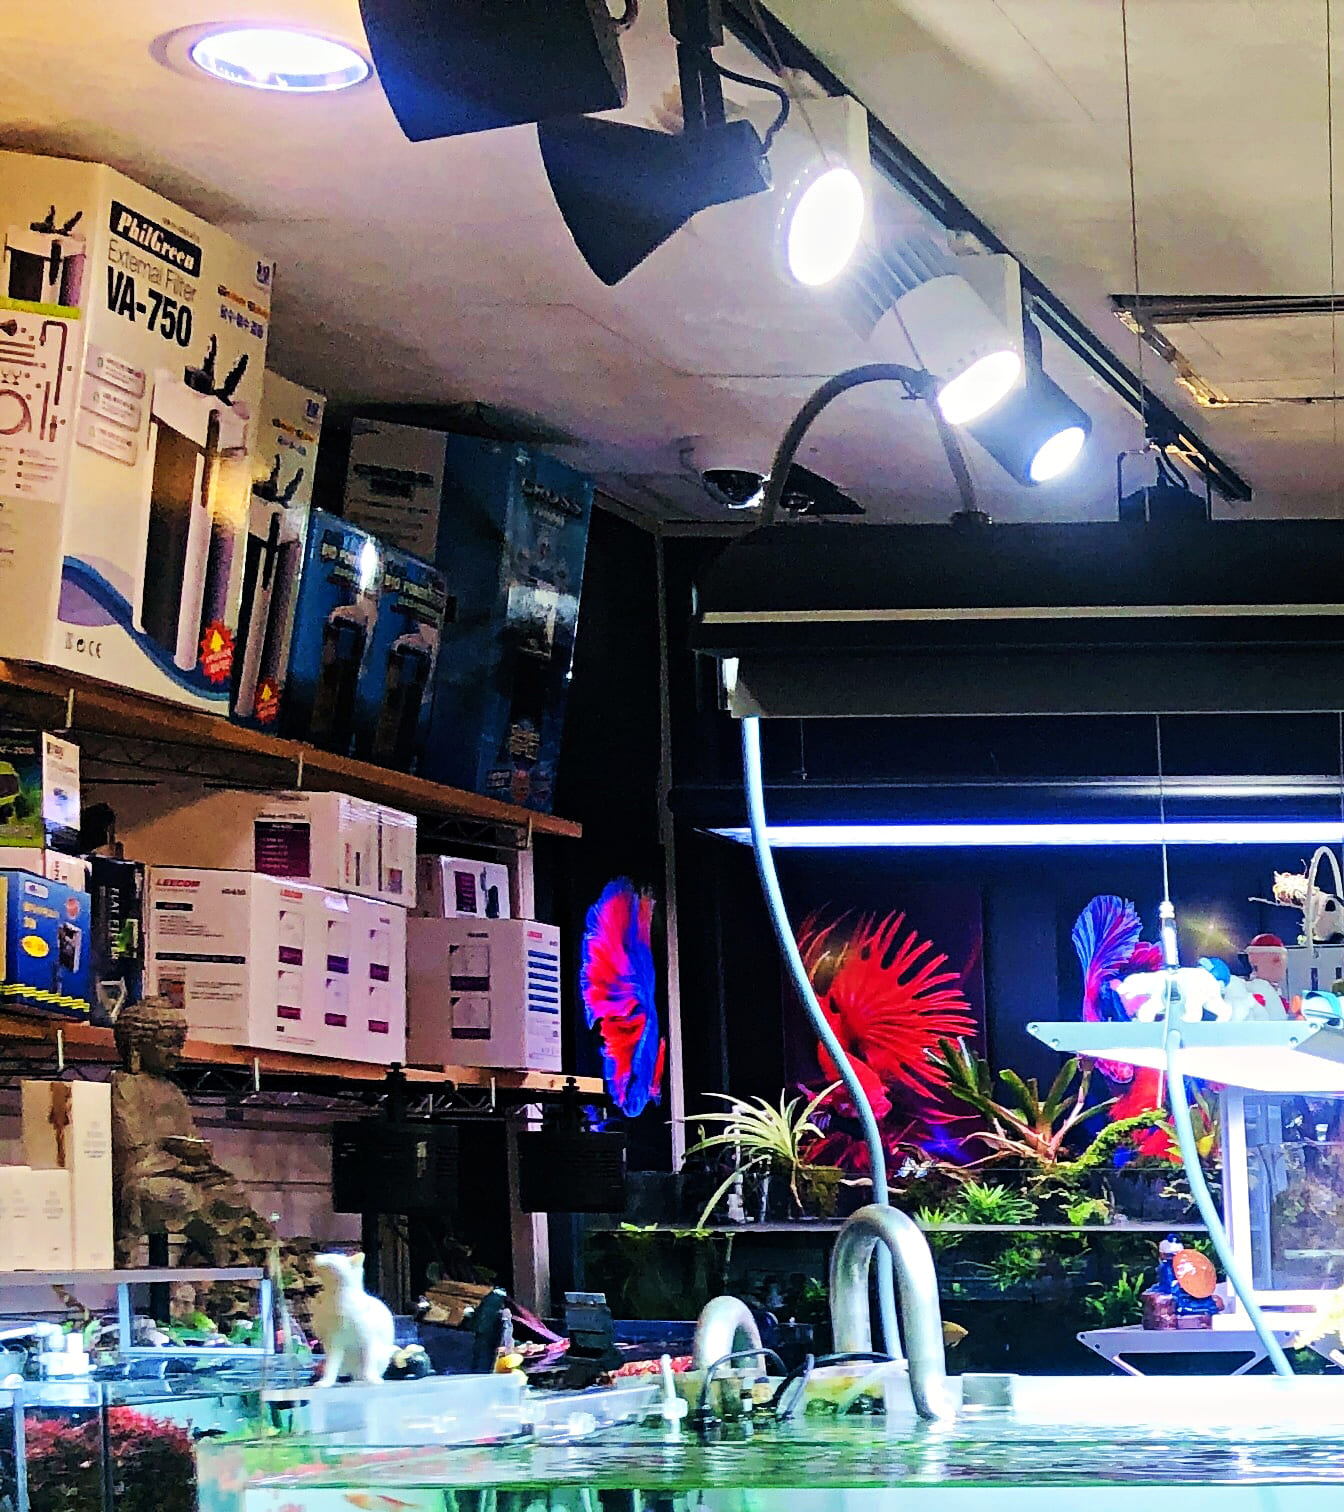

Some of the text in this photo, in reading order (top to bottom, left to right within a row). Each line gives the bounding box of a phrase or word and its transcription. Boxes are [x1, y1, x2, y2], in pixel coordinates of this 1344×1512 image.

[107, 239, 197, 302] External Filter
[117, 211, 196, 271] PhilGreen
[106, 265, 193, 348] VA-750
[108, 887, 121, 917] FLAT
[156, 878, 201, 888] LEECOM
